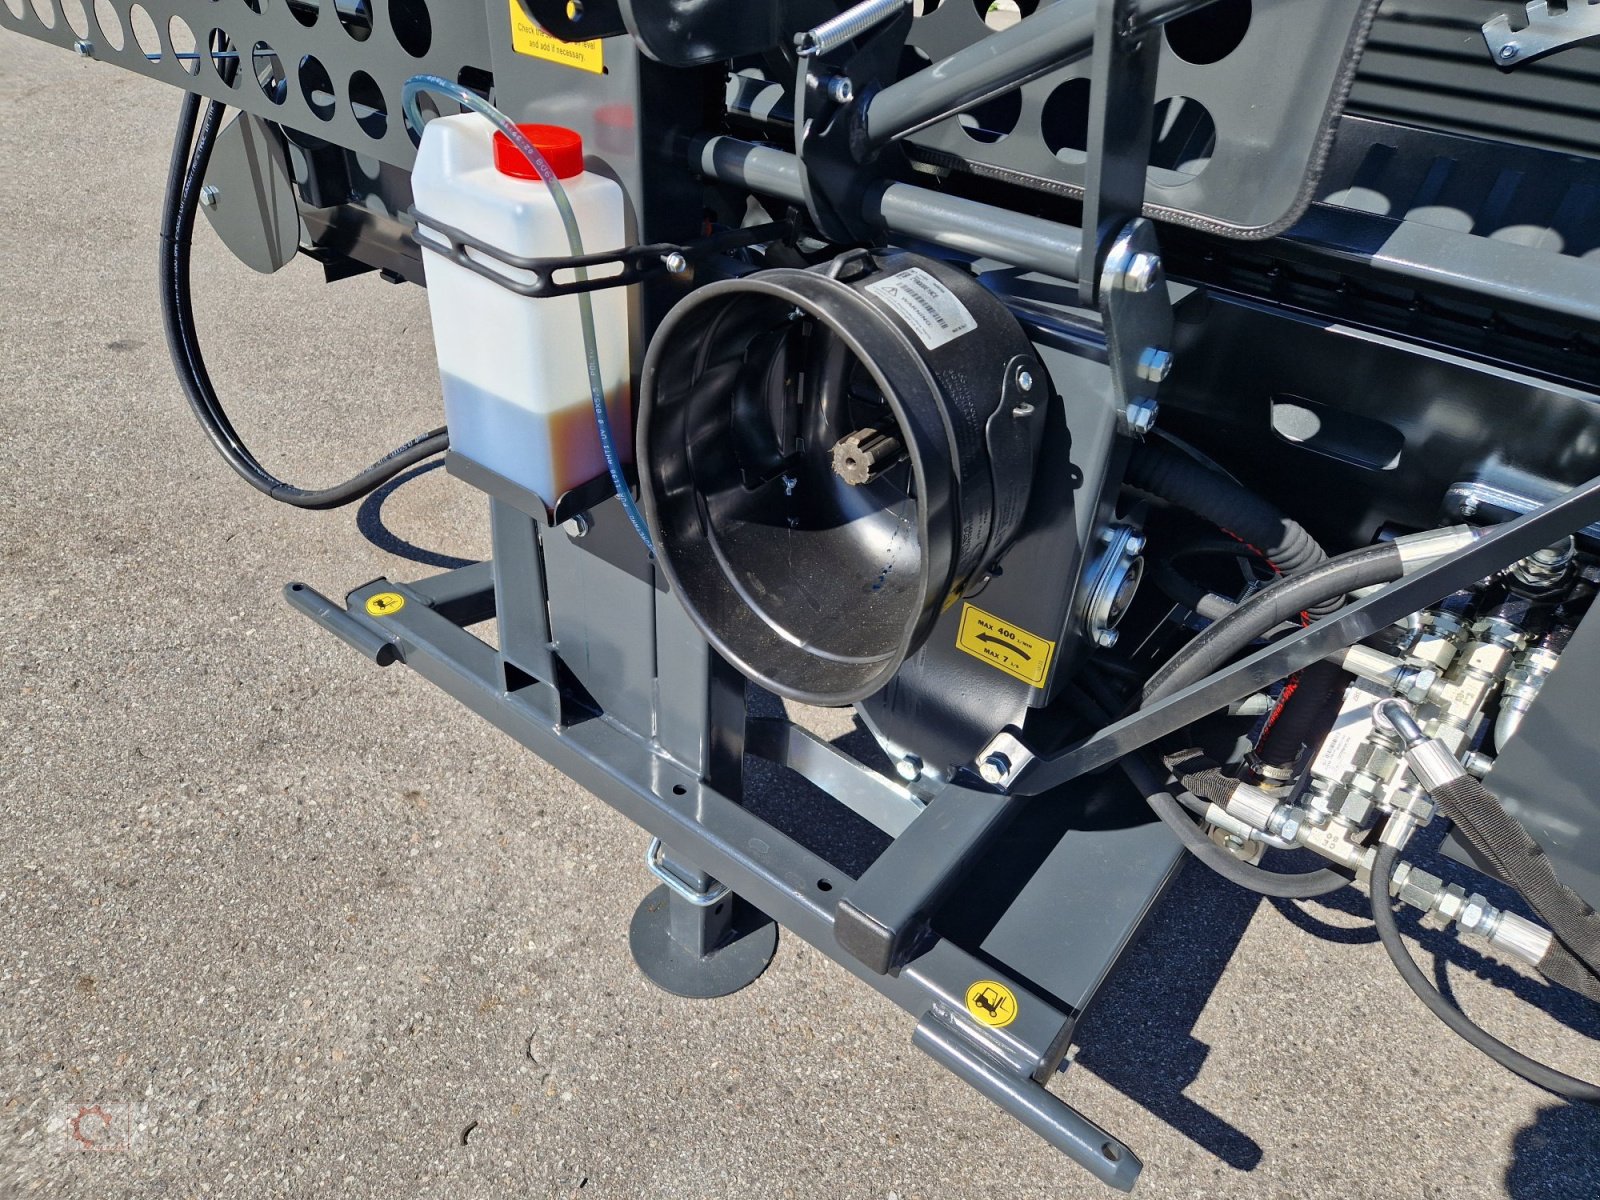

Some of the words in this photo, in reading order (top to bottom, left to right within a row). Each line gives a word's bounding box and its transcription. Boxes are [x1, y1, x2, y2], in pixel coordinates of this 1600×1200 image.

[517, 22, 534, 34] Check
[529, 41, 539, 49] and
[541, 43, 551, 52] add
[977, 619, 994, 631] MAX
[997, 627, 1016, 640] 400
[983, 647, 1000, 659] MAX
